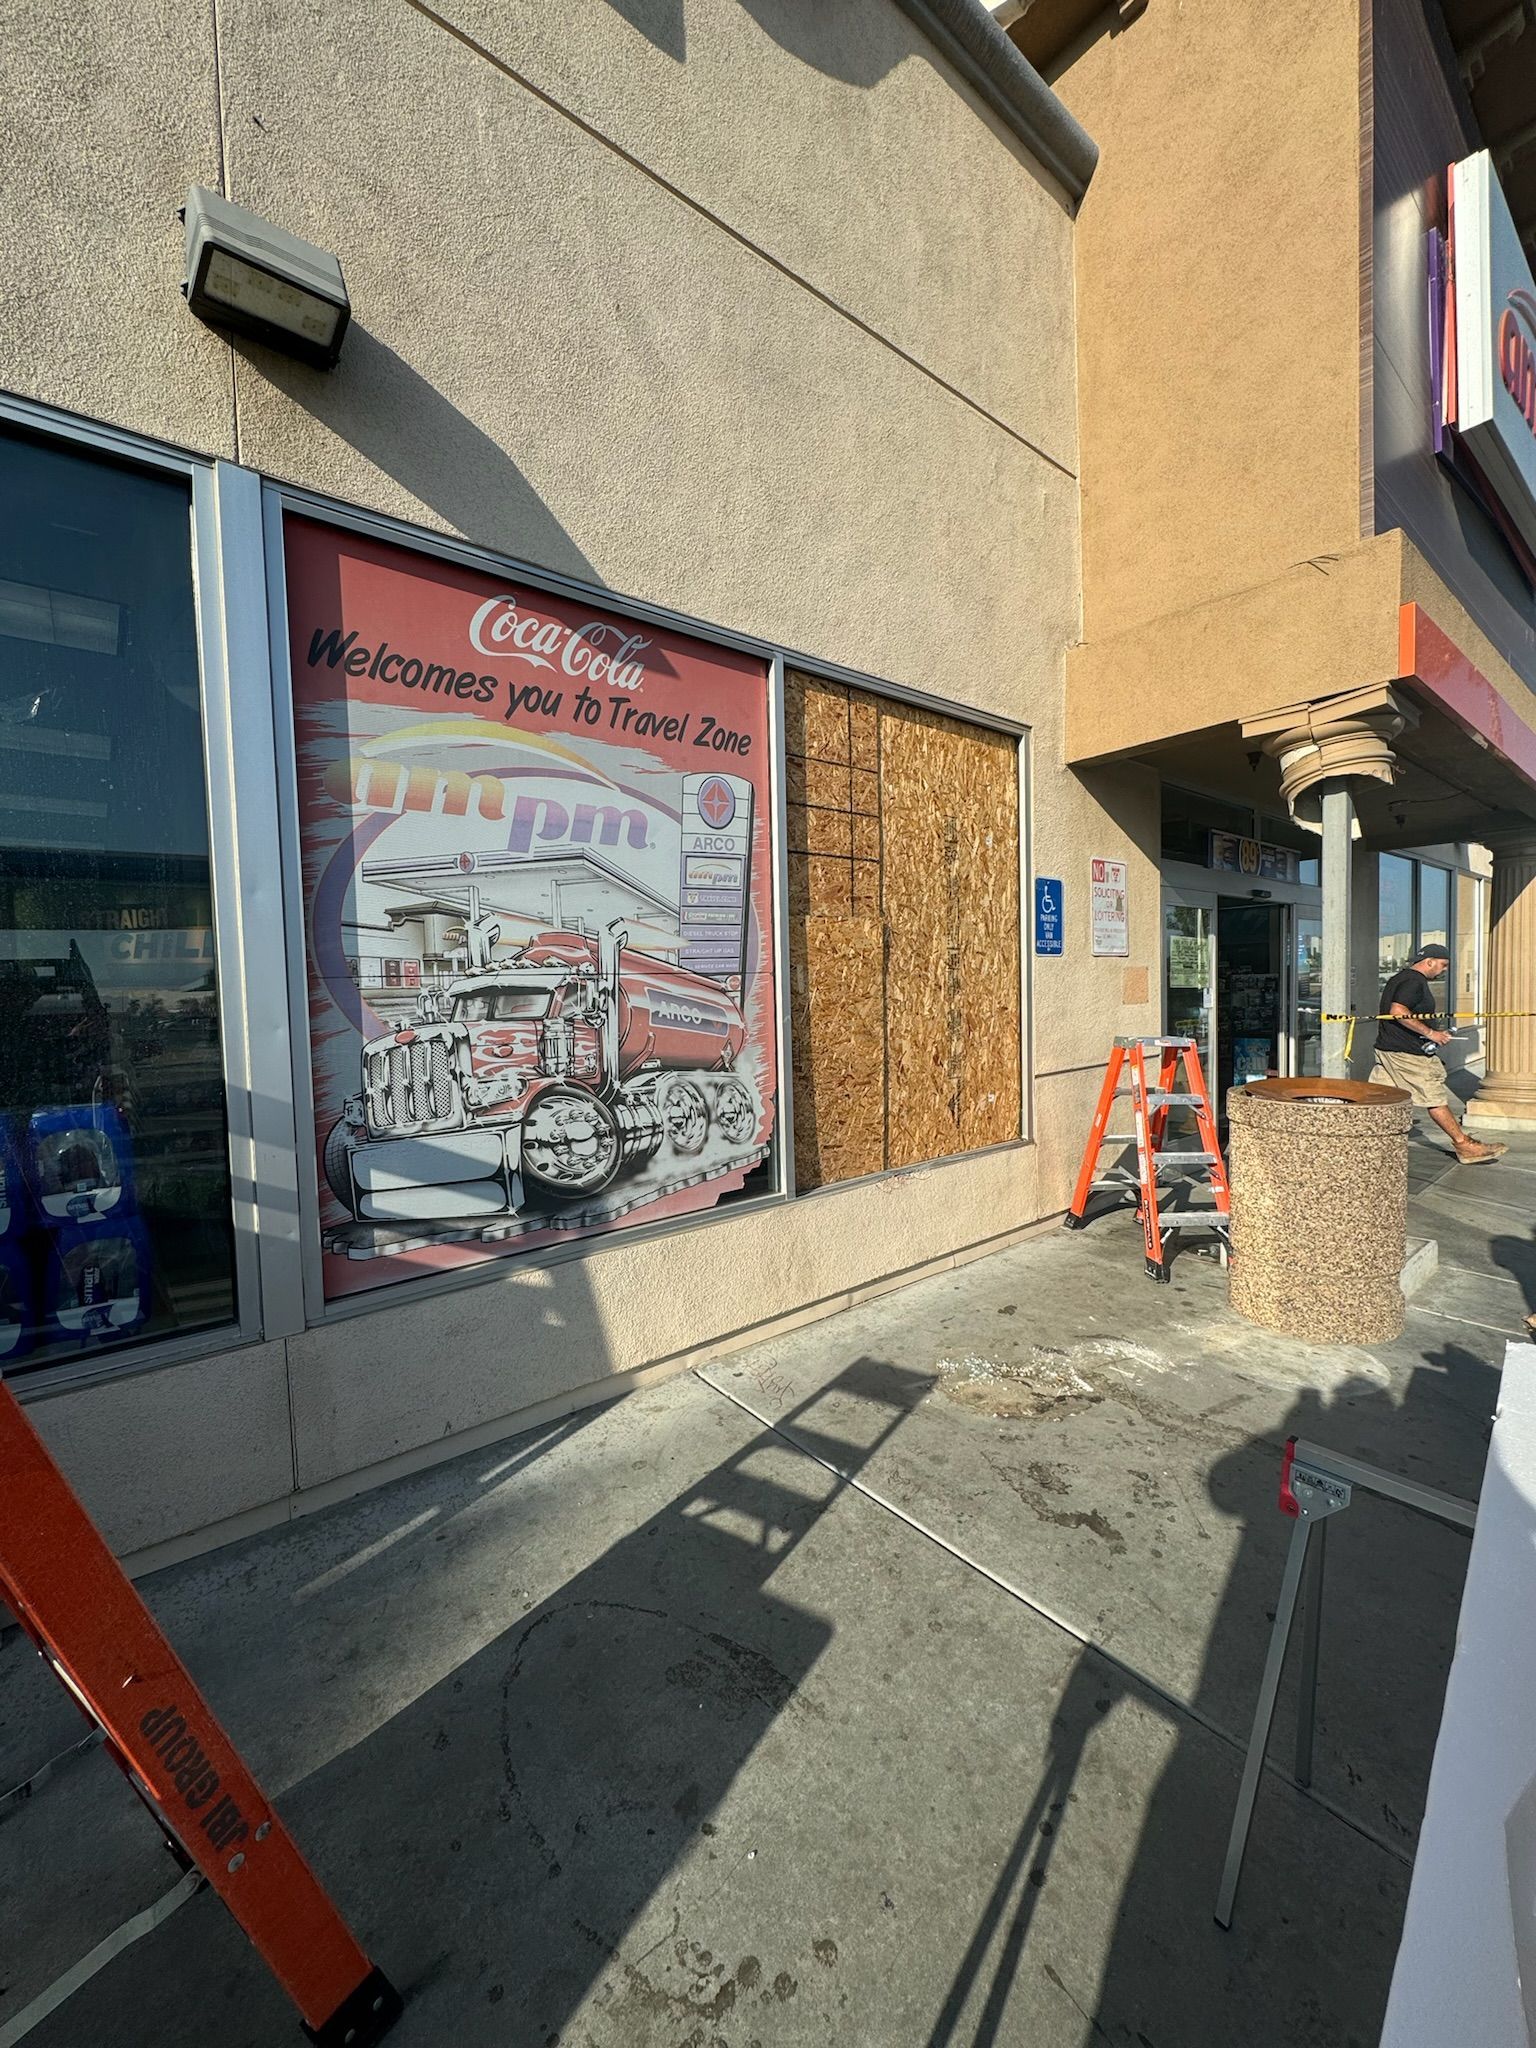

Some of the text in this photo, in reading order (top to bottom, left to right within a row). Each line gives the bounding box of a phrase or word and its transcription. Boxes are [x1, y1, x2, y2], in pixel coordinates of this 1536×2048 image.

[469, 594, 653, 691] Coca-Cola
[306, 627, 752, 757] Welcomes you to Travel Zone
[693, 836, 735, 852] ARCO
[1093, 862, 1104, 881] NO
[1094, 910, 1125, 922] LOITERING
[658, 1001, 702, 1025] ARCO
[139, 1704, 250, 1854] JBI GROUP
